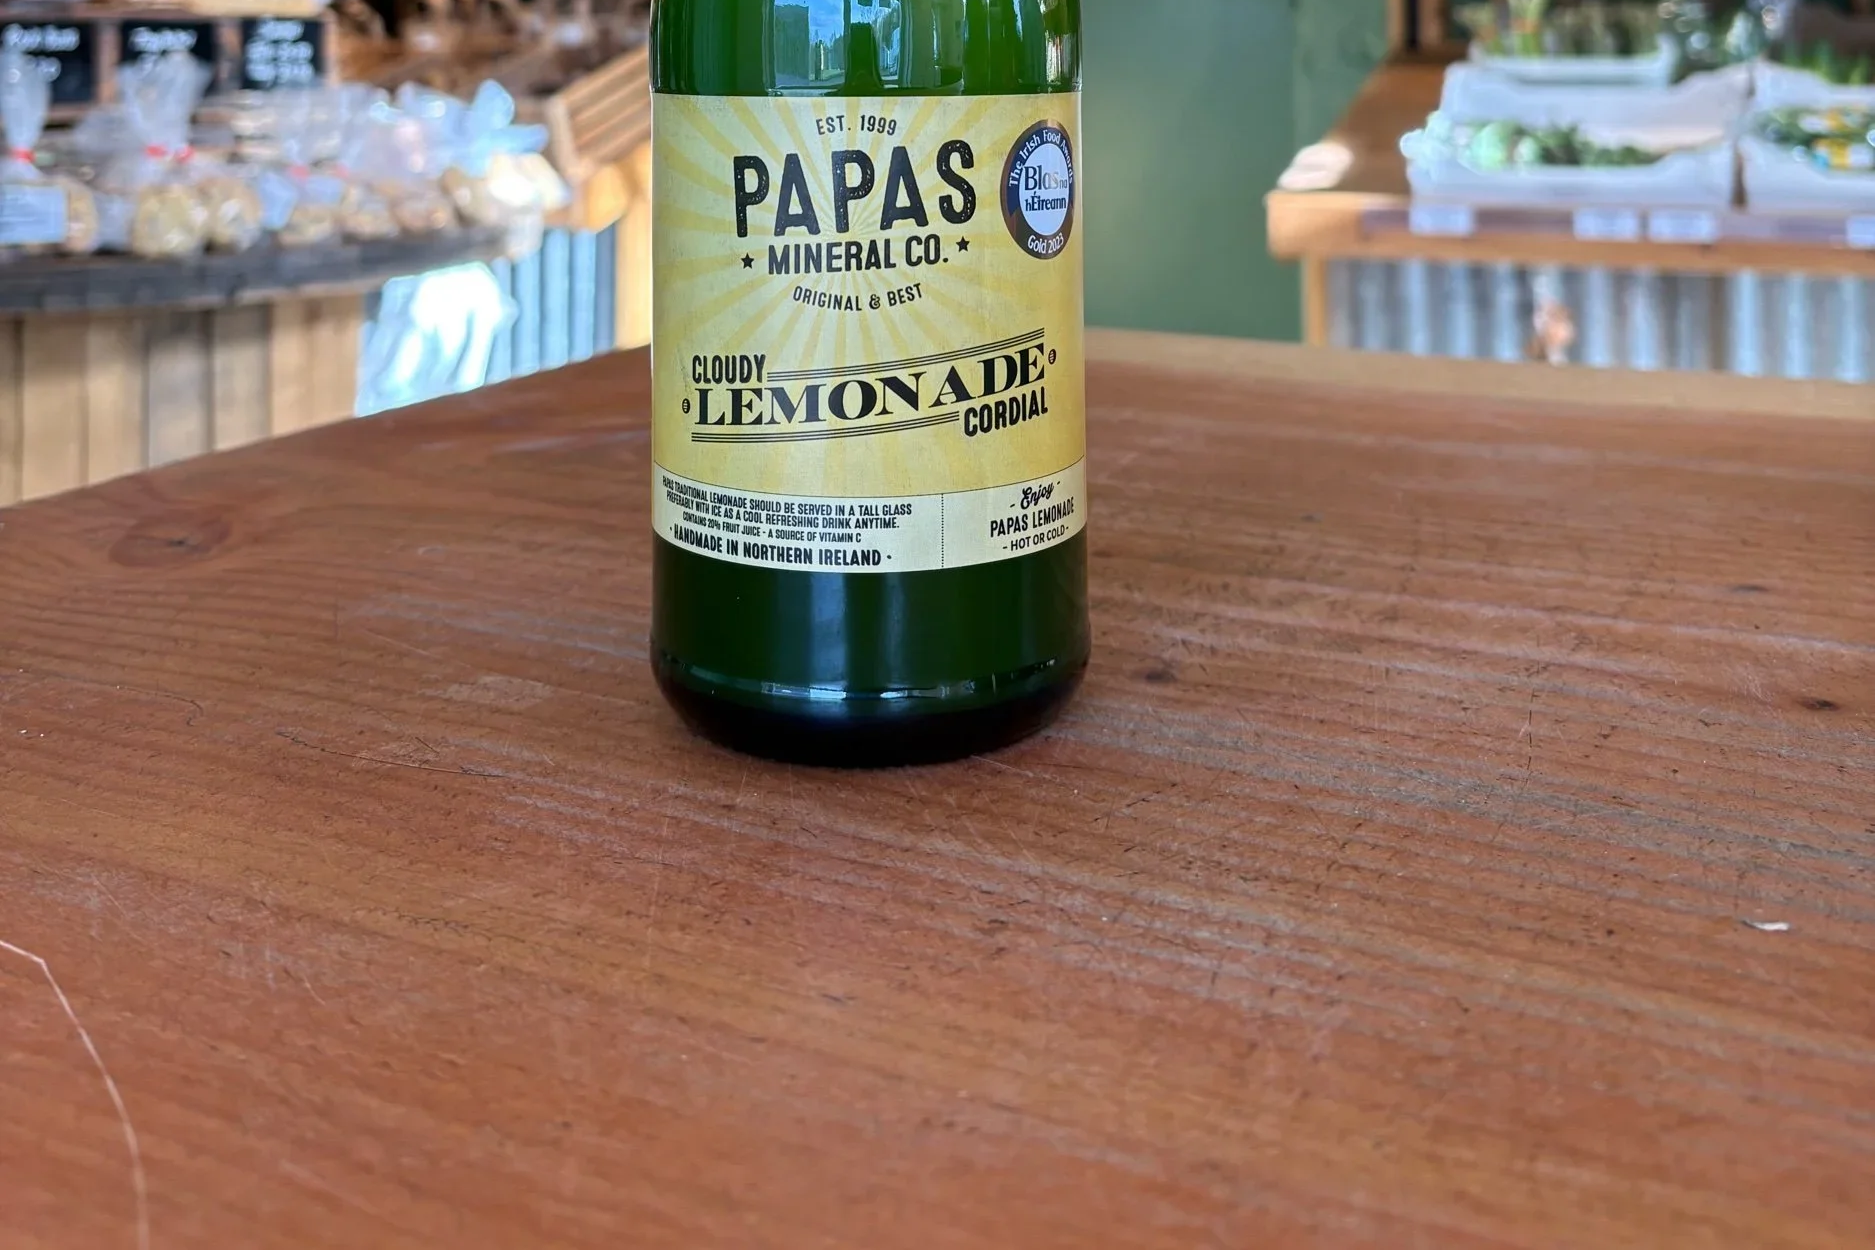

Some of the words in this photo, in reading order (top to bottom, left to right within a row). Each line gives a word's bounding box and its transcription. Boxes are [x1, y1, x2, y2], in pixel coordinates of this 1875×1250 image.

[816, 115, 851, 135] EST.
[861, 115, 897, 136] 1999
[1009, 160, 1024, 187] The
[1019, 135, 1041, 159] Irish
[1043, 130, 1061, 144] Food
[1060, 140, 1073, 184] Awards
[734, 140, 976, 237] PAPAS
[1024, 165, 1059, 191] Blas
[1059, 178, 1068, 189] na
[1025, 191, 1067, 211] hÉireann
[769, 239, 896, 275] MINERAL
[905, 234, 949, 267] CO.
[1028, 235, 1047, 253] Gold
[1048, 233, 1064, 253] 2023
[793, 286, 862, 311] ORIGINAL
[869, 294, 881, 310] &
[887, 283, 923, 307] BEST
[692, 354, 766, 385] CLOUDY
[695, 343, 1045, 426] LEMONADE
[963, 386, 1048, 437] CORDIAL
[662, 475, 674, 490] PAPAS
[675, 481, 708, 502] TRADITIONAL
[710, 492, 747, 509] LEMONADE
[749, 499, 781, 513] SHOULD
[784, 502, 795, 514] BE
[797, 503, 832, 516] SERVED
[835, 505, 845, 516] IN
[848, 505, 855, 516] A
[858, 505, 880, 516] TALL
[882, 503, 912, 516] GLASS
[666, 489, 694, 510] PREFERABLY
[695, 501, 710, 515] WITH
[711, 505, 722, 518] ICE
[723, 507, 734, 519] AS
[735, 509, 741, 521] A
[743, 510, 763, 524] COOL
[765, 513, 819, 528] REFRESHING
[822, 517, 852, 529] DRINK
[854, 517, 900, 529] ANYTIME.
[1020, 482, 1054, 510] Enjoy
[683, 511, 707, 527] CONTAINS
[708, 519, 721, 530] 20%
[722, 521, 740, 534] FRUIT
[741, 524, 760, 537] JUICE
[768, 528, 774, 538] A
[775, 529, 804, 541] SOURCE
[807, 531, 817, 542] OF
[819, 532, 853, 543] VITAMIN
[856, 532, 862, 543] C
[990, 513, 1028, 538] PAPAS
[1032, 496, 1074, 529] LEMONADE
[674, 523, 722, 553] HANDMADE
[726, 538, 739, 556] IN
[743, 541, 813, 565] NORTHERN
[818, 548, 882, 566] IRELAND
[1011, 536, 1031, 551] HOT
[1032, 532, 1045, 546] OR
[1046, 524, 1065, 541] COLD
